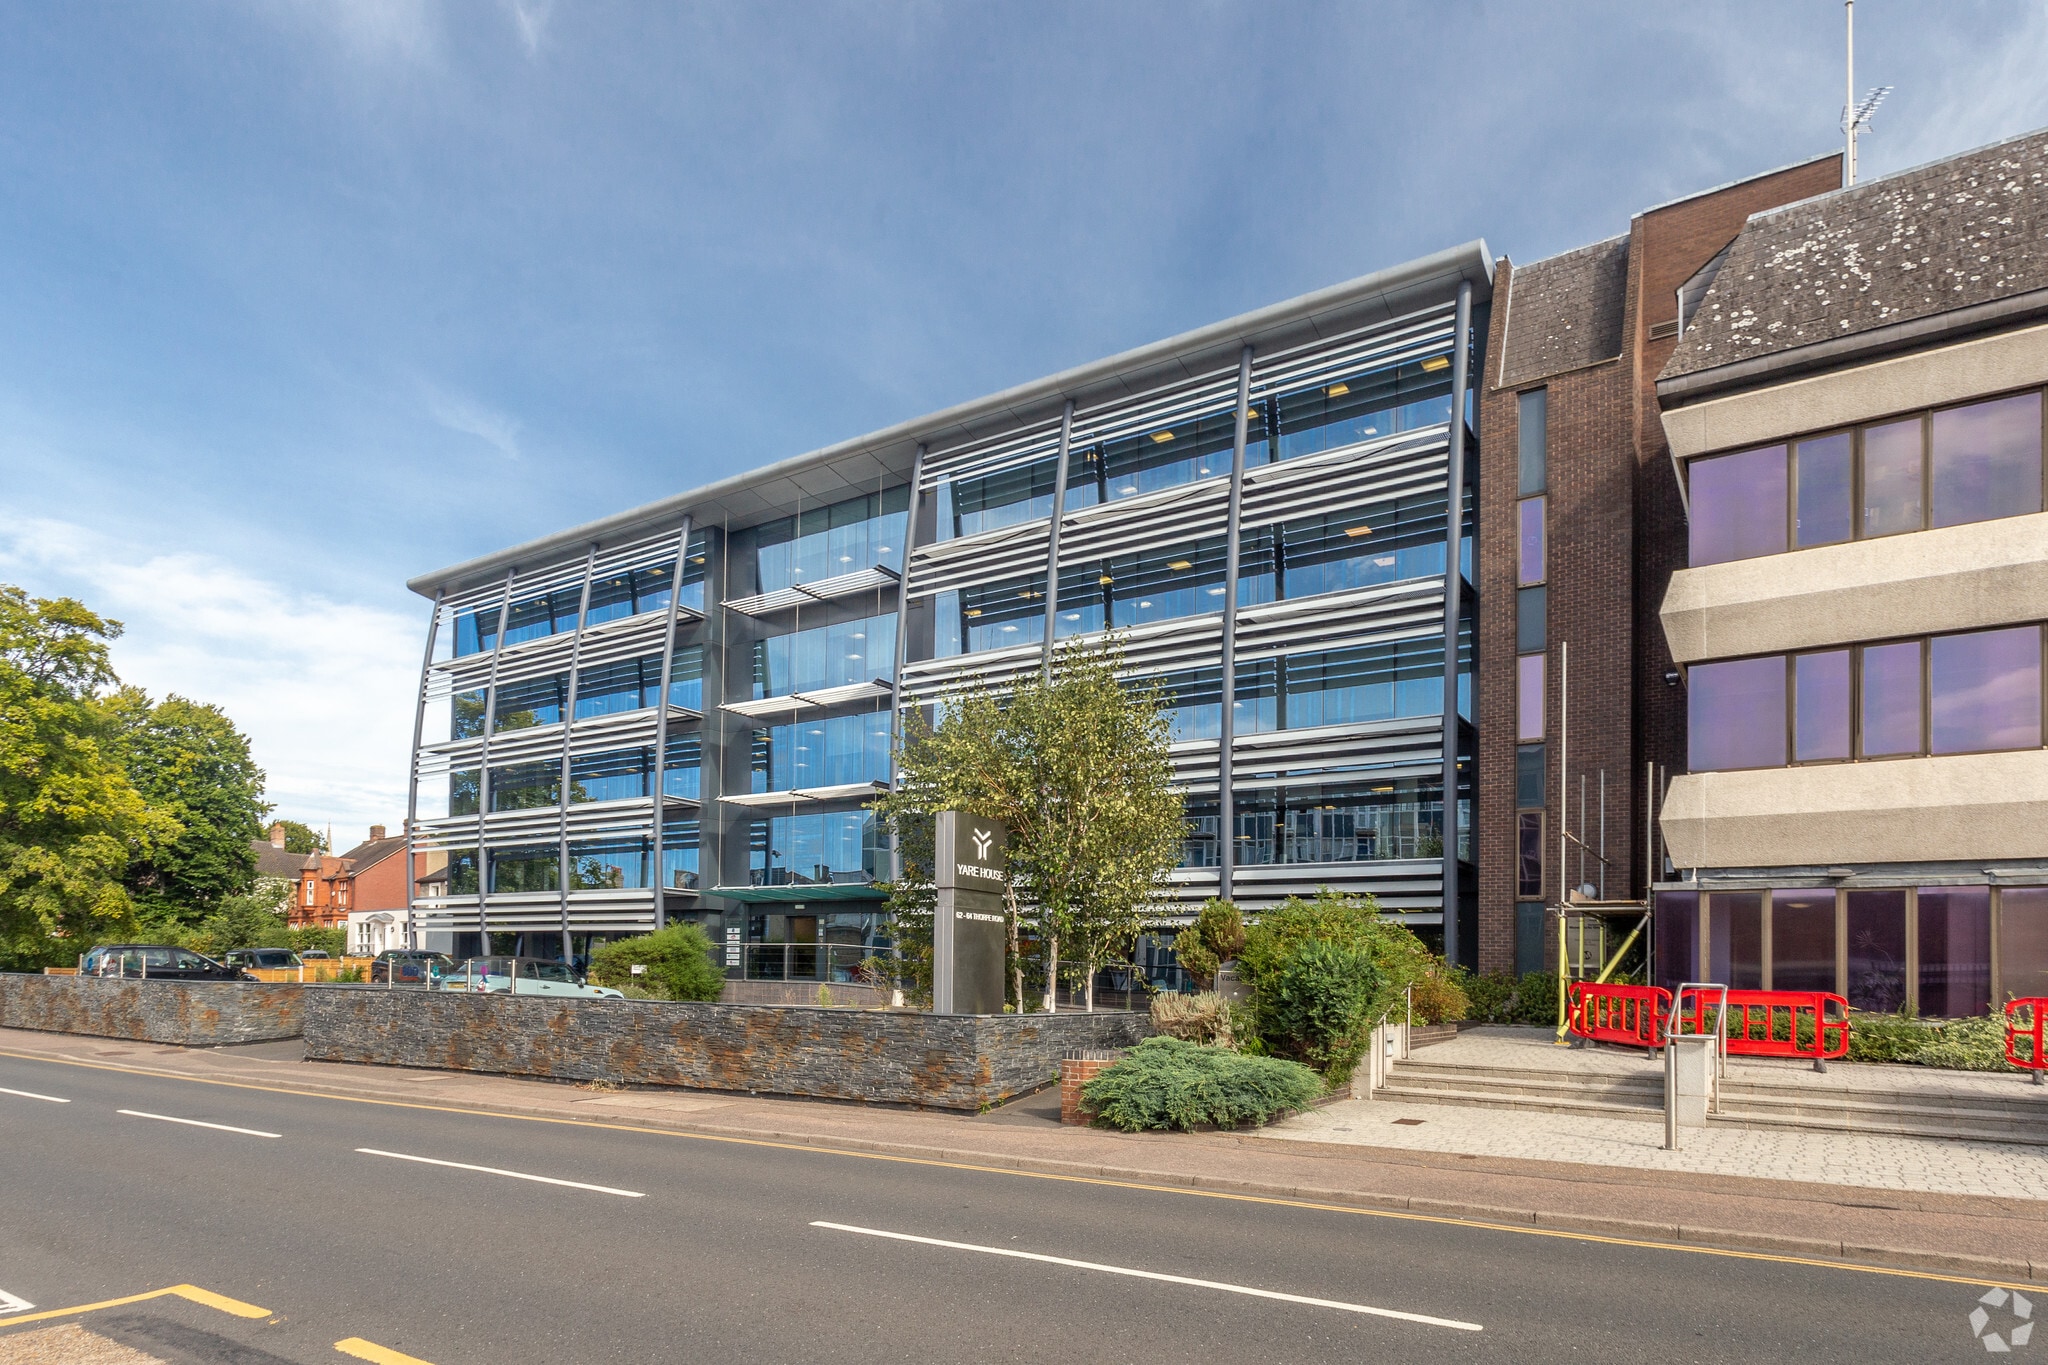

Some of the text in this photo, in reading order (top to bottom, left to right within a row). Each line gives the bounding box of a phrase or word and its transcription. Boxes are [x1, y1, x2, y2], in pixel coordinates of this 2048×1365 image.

[957, 863, 1004, 882] YARE HOUSE
[1220, 974, 1242, 982] Vaca
